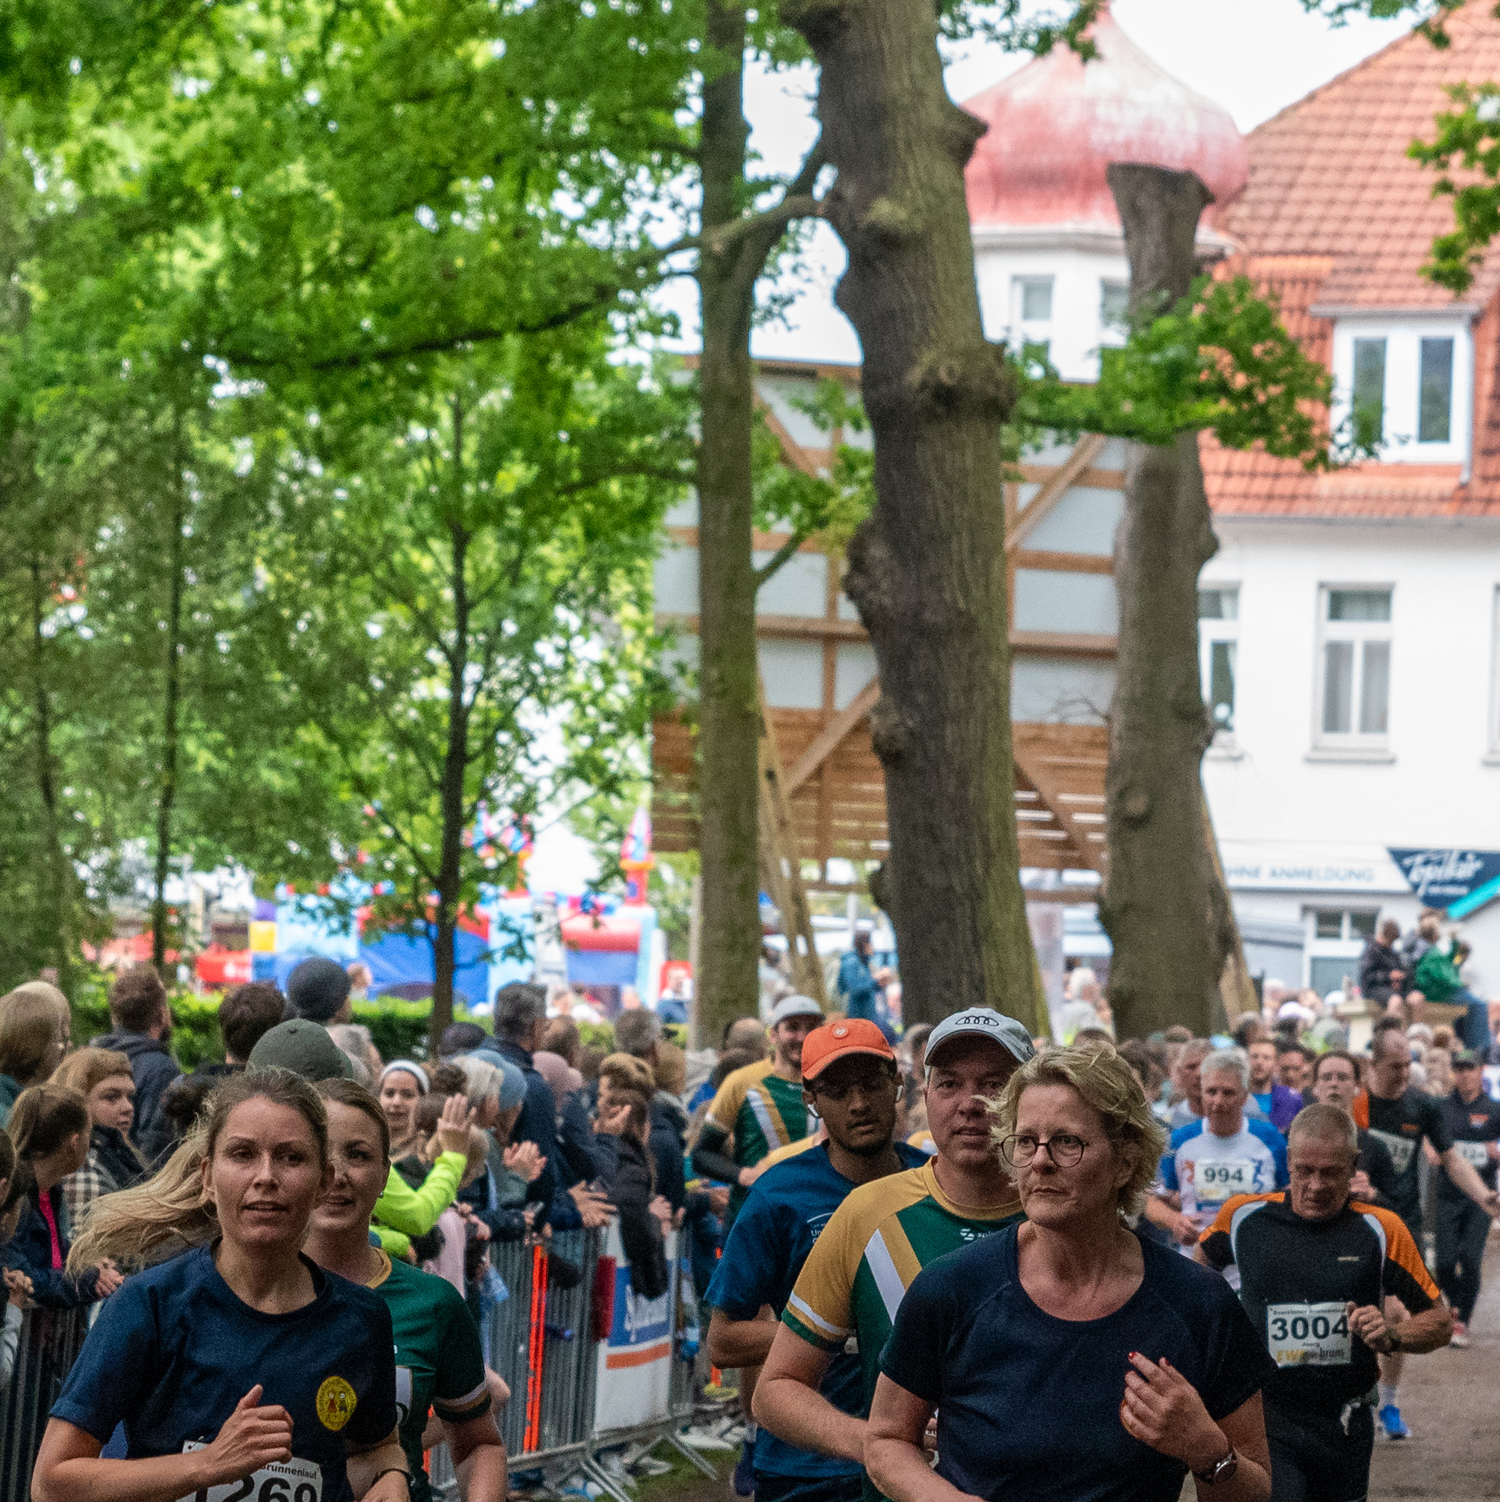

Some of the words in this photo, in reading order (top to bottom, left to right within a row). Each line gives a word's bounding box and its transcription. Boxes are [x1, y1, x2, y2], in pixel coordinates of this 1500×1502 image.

[1225, 866, 1261, 880] HNE
[1269, 867, 1375, 882] ANMELDUNG
[1204, 1167, 1244, 1183] 994
[1271, 1315, 1349, 1341] 3004
